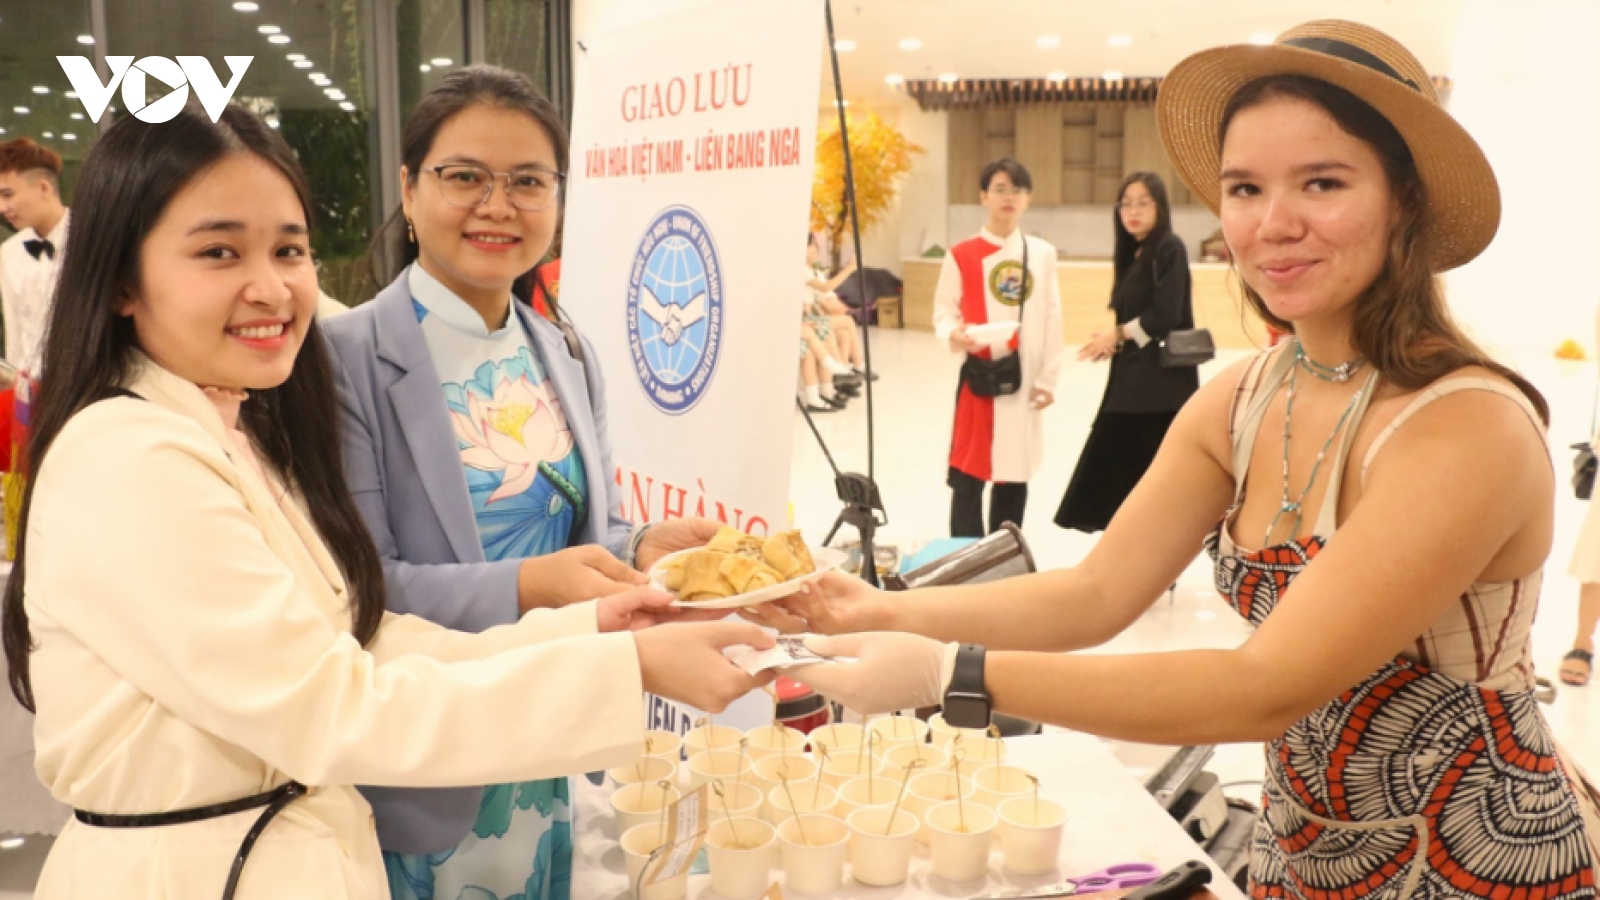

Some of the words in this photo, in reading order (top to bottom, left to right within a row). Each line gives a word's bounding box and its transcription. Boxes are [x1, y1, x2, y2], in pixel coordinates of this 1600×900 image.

[620, 76, 687, 122] GIAO
[693, 62, 753, 112] LƯU
[631, 136, 654, 183] VIỆT
[656, 139, 683, 174] NAM
[726, 129, 765, 169] BANG
[768, 126, 801, 167] NGA
